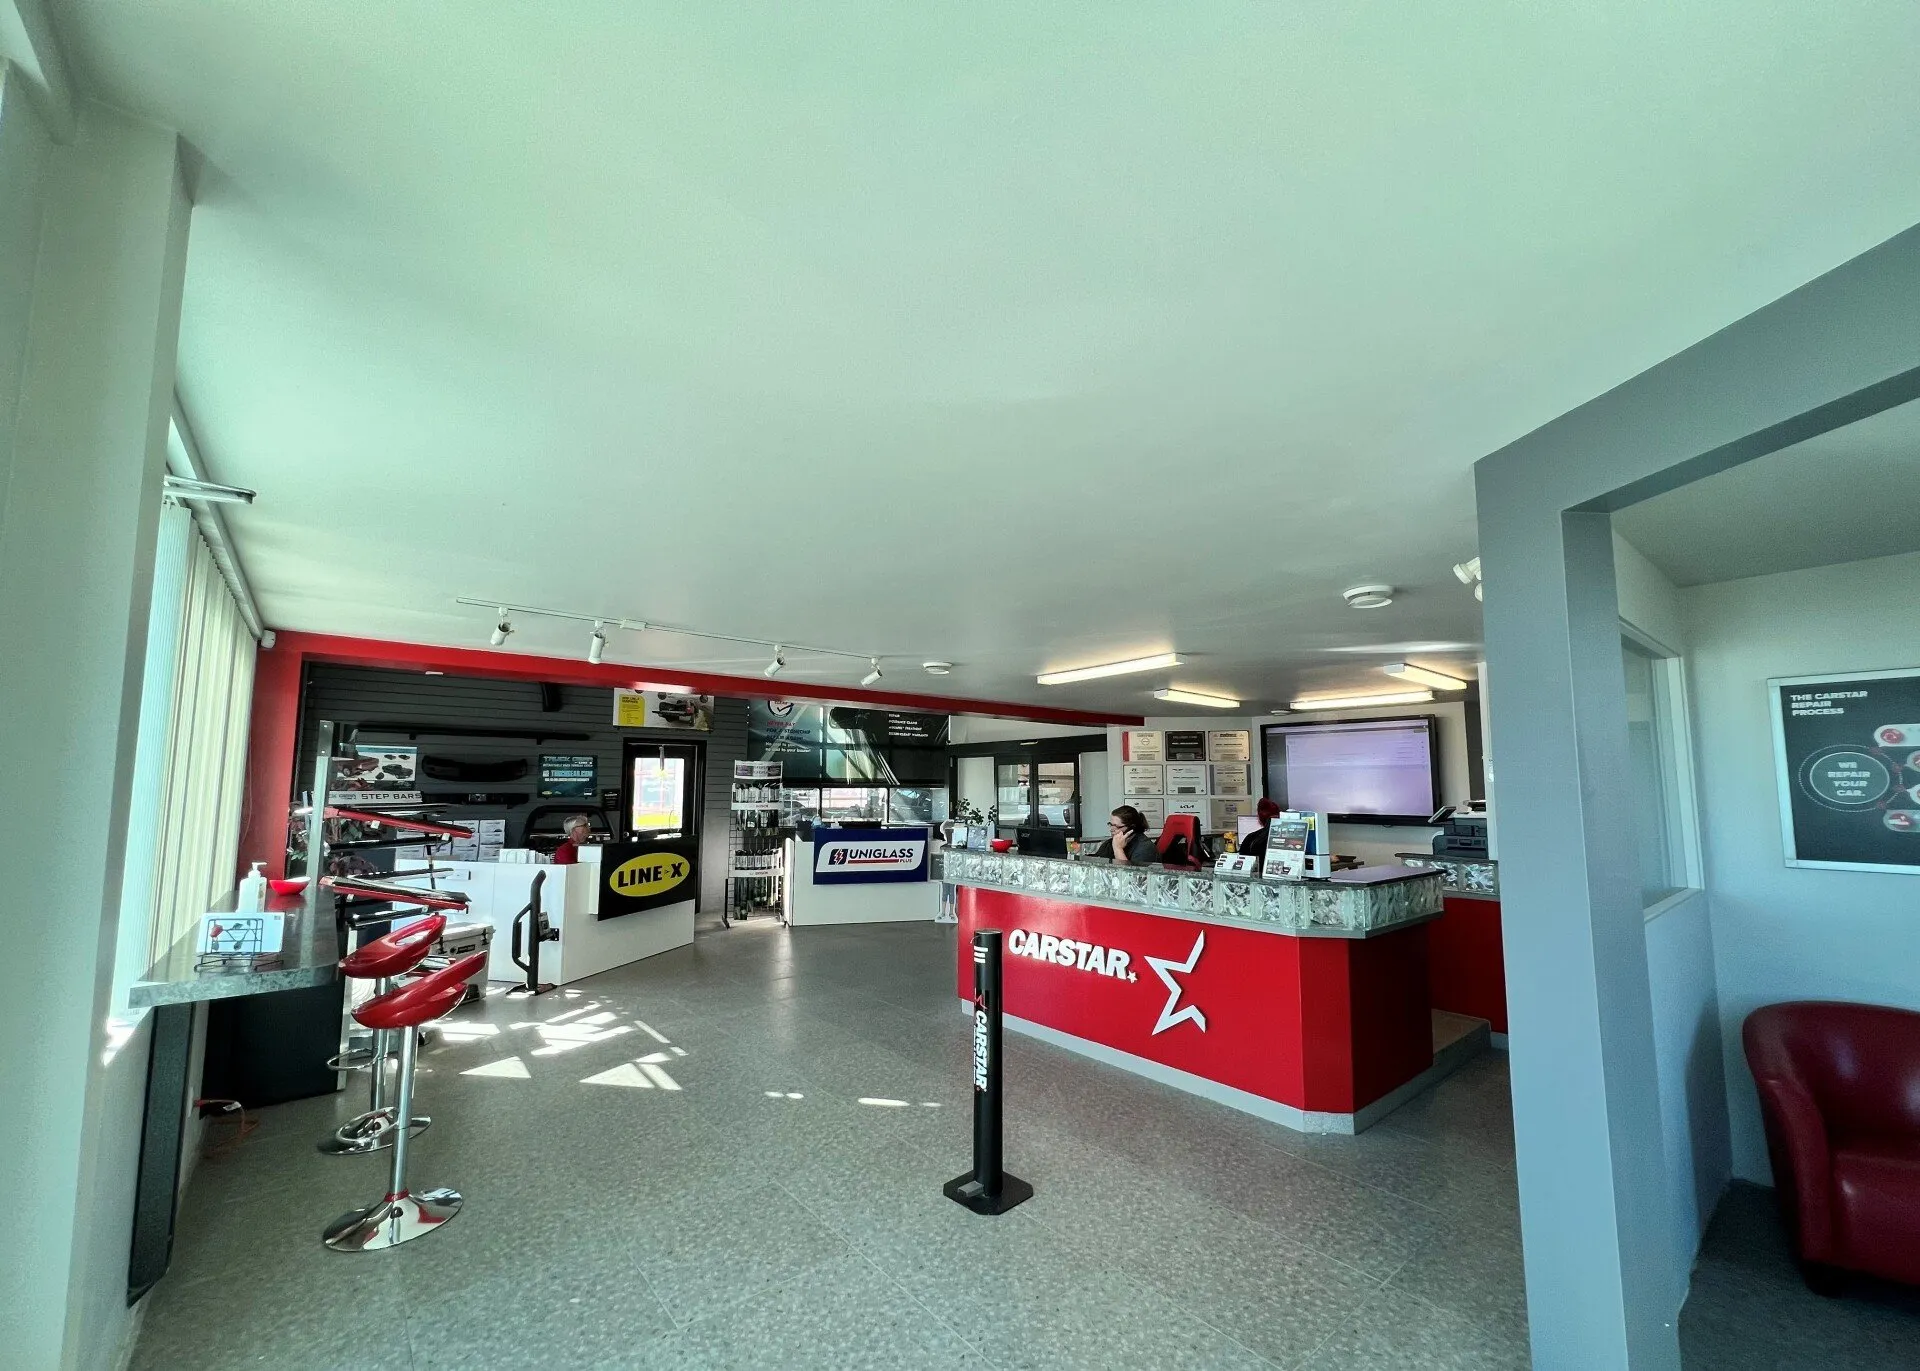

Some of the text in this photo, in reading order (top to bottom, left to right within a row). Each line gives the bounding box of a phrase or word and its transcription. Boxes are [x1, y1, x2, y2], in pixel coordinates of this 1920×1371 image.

[1790, 690, 1868, 701] THE CARSTAR
[1791, 700, 1832, 709] REPAIR
[1792, 707, 1845, 716] PROCESS
[1838, 761, 1858, 769] WE
[1836, 789, 1866, 797] CAR.
[849, 848, 914, 859] UNIGLASS
[1008, 928, 1131, 981] CARSTAR
[974, 1010, 988, 1091] CARSTAR
